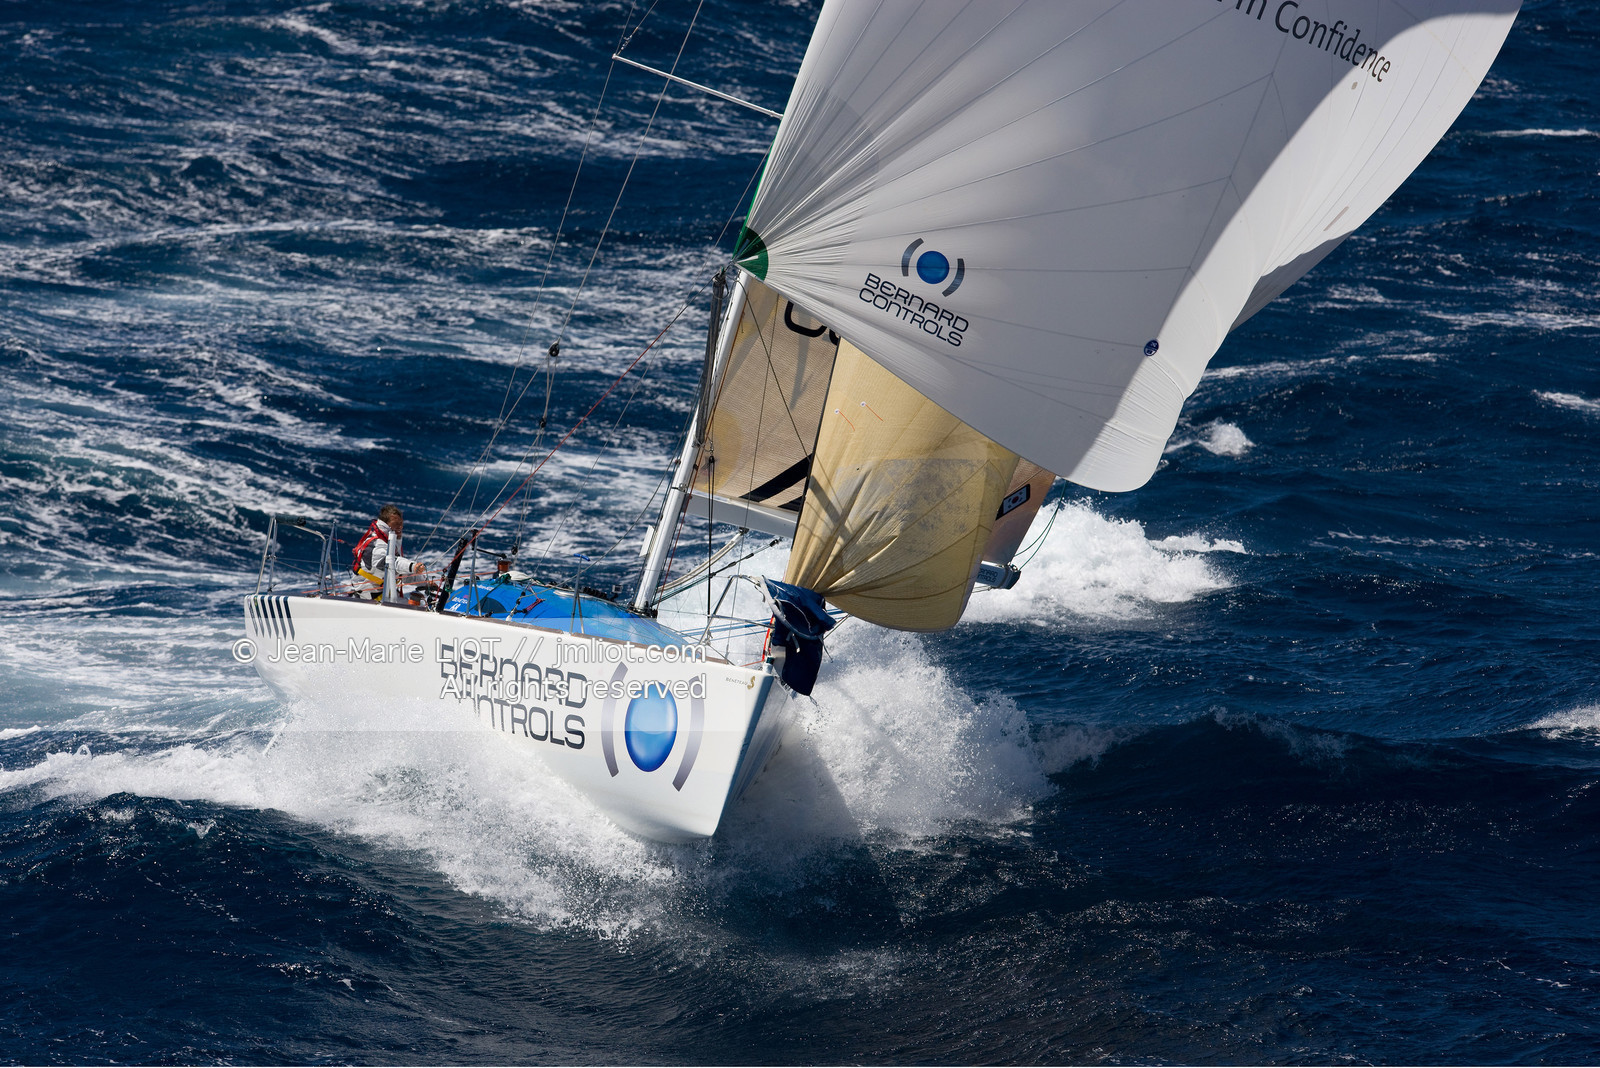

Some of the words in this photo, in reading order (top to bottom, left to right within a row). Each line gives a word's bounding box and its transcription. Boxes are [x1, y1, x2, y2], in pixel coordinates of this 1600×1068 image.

[1274, 0, 1391, 82] Confidence
[859, 288, 963, 347] CONTROLS
[865, 273, 969, 333] BERNARD
[441, 644, 588, 708] BERNARD
[443, 686, 585, 749] NTROLS
